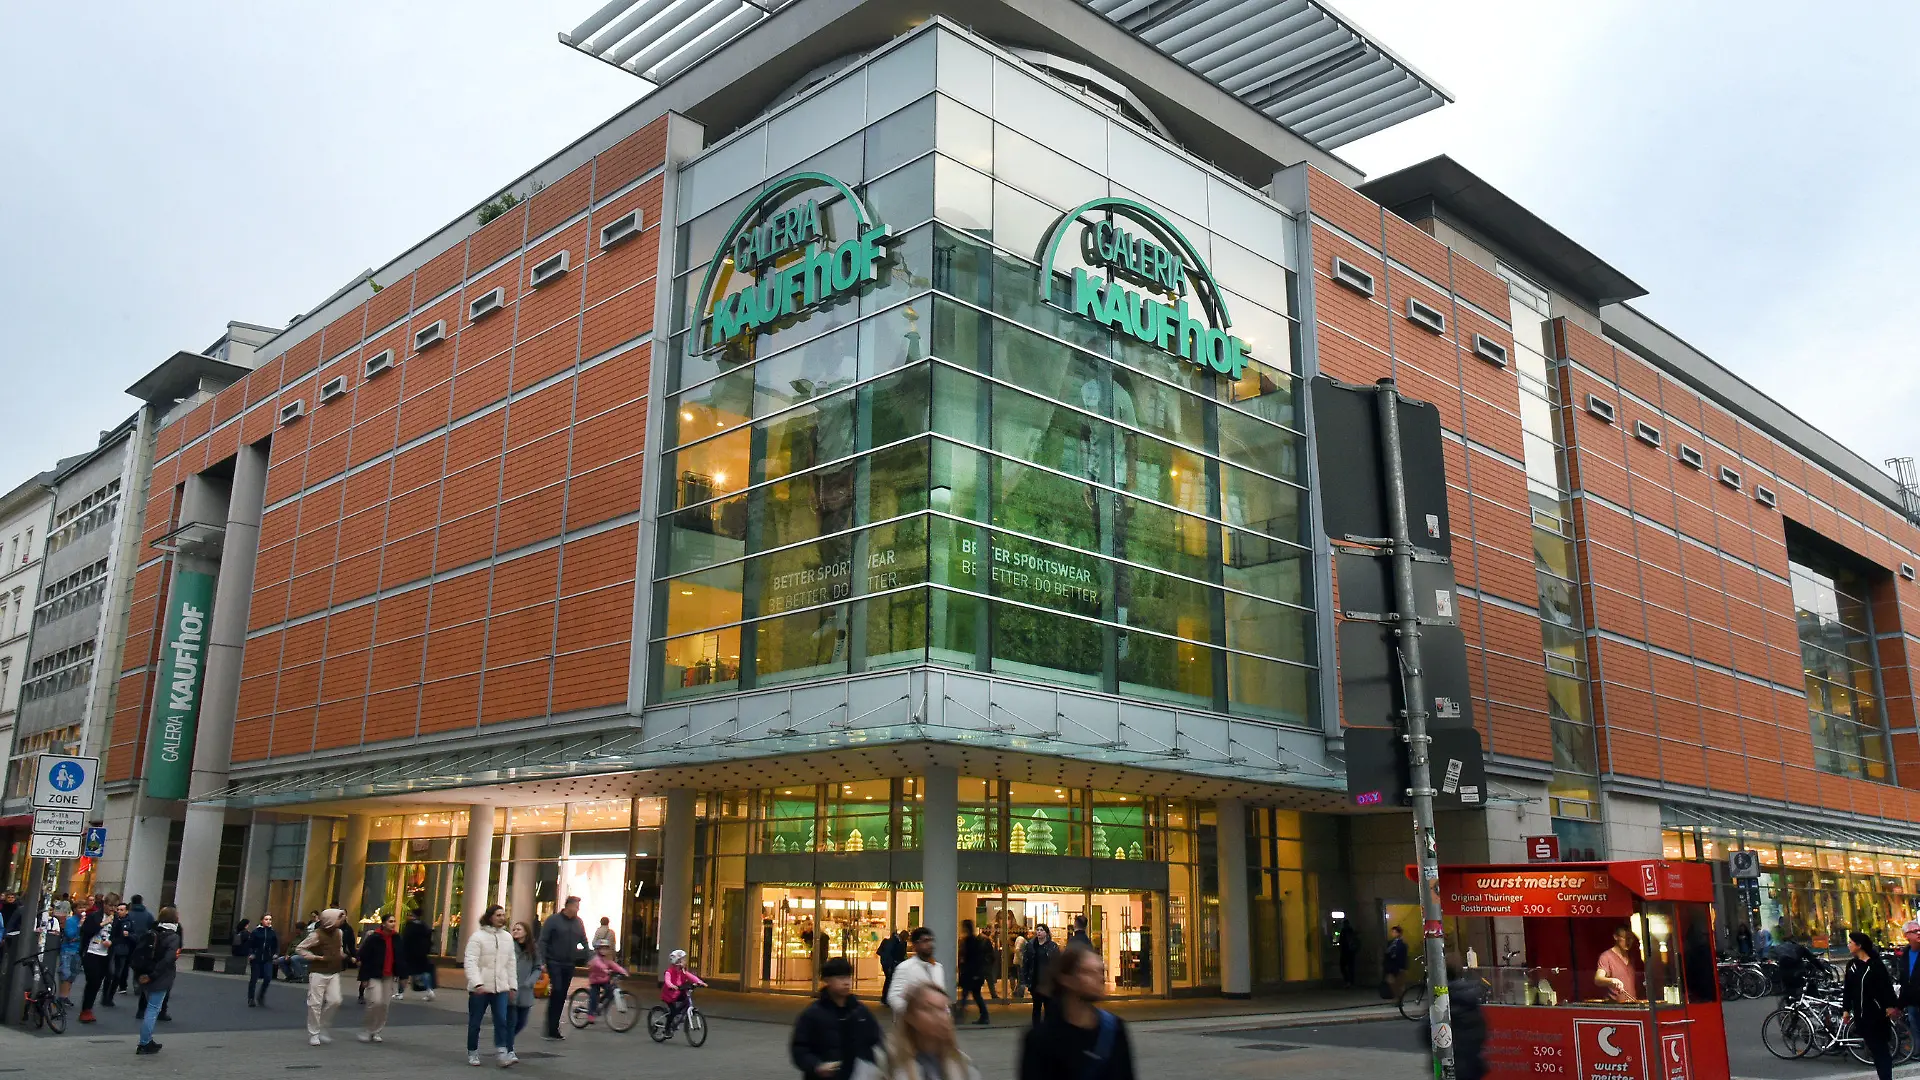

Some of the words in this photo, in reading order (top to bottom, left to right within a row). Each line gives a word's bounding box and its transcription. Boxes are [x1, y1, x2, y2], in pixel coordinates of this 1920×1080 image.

[734, 199, 819, 273] GALERIA
[1097, 220, 1188, 297] GALERIA
[962, 539, 1010, 564] BEER
[1013, 553, 1091, 583] SPORTSWEAR
[773, 570, 815, 590] BETTER
[1035, 577, 1050, 593] DO
[1054, 583, 1100, 605] BETTER.
[769, 597, 784, 612] BE
[833, 583, 849, 599] DO
[161, 715, 184, 762] GALERIA
[48, 795, 79, 804] ZONE
[1452, 893, 1482, 902] Original
[1484, 893, 1524, 902] Thüringer
[1557, 892, 1607, 902] Currywurst
[1460, 904, 1511, 912] Rostbratwurst
[1523, 904, 1545, 914] 3,90
[1546, 906, 1552, 914] €
[1571, 904, 1593, 914] 3,90
[1596, 906, 1601, 914] €
[1533, 1046, 1555, 1057] 3,90
[1557, 1048, 1563, 1057] €
[1534, 1062, 1556, 1073] 3,90
[1558, 1066, 1564, 1074] €
[1594, 1062, 1629, 1072] wurst
